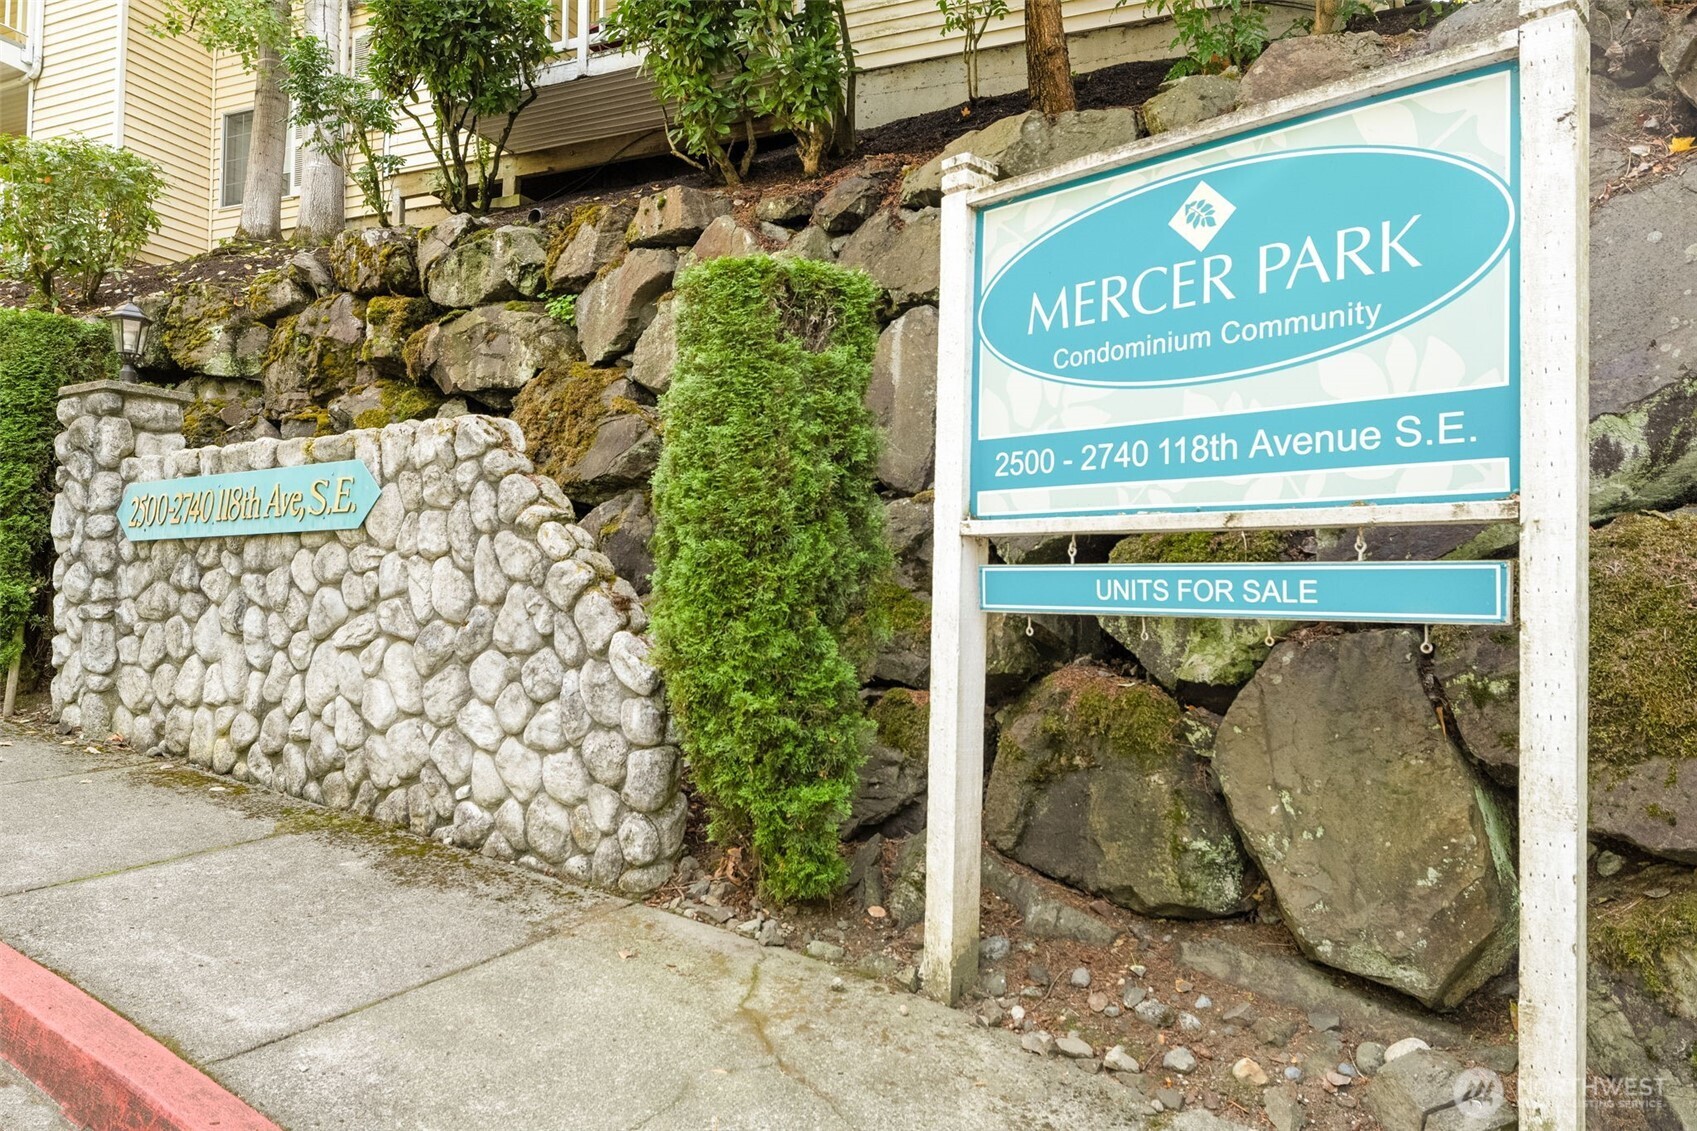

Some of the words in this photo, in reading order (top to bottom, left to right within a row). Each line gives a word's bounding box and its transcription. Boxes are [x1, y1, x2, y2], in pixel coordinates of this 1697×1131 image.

[1027, 253, 1236, 335] MERCER
[1258, 213, 1423, 295] PARK
[1053, 330, 1211, 370] Condominium
[1220, 303, 1382, 345] Community
[994, 447, 1055, 477] 2500
[1080, 441, 1149, 471] 2740
[1158, 432, 1238, 465] 118th
[1248, 426, 1382, 459] Avenue
[1395, 410, 1477, 448] S.E.
[128, 489, 215, 528] 2500-2740
[215, 486, 261, 523] 118th
[309, 477, 357, 516] S.E.
[1096, 578, 1170, 602] UNITS
[1177, 579, 1235, 603] FOR
[1242, 579, 1319, 604] SALE
